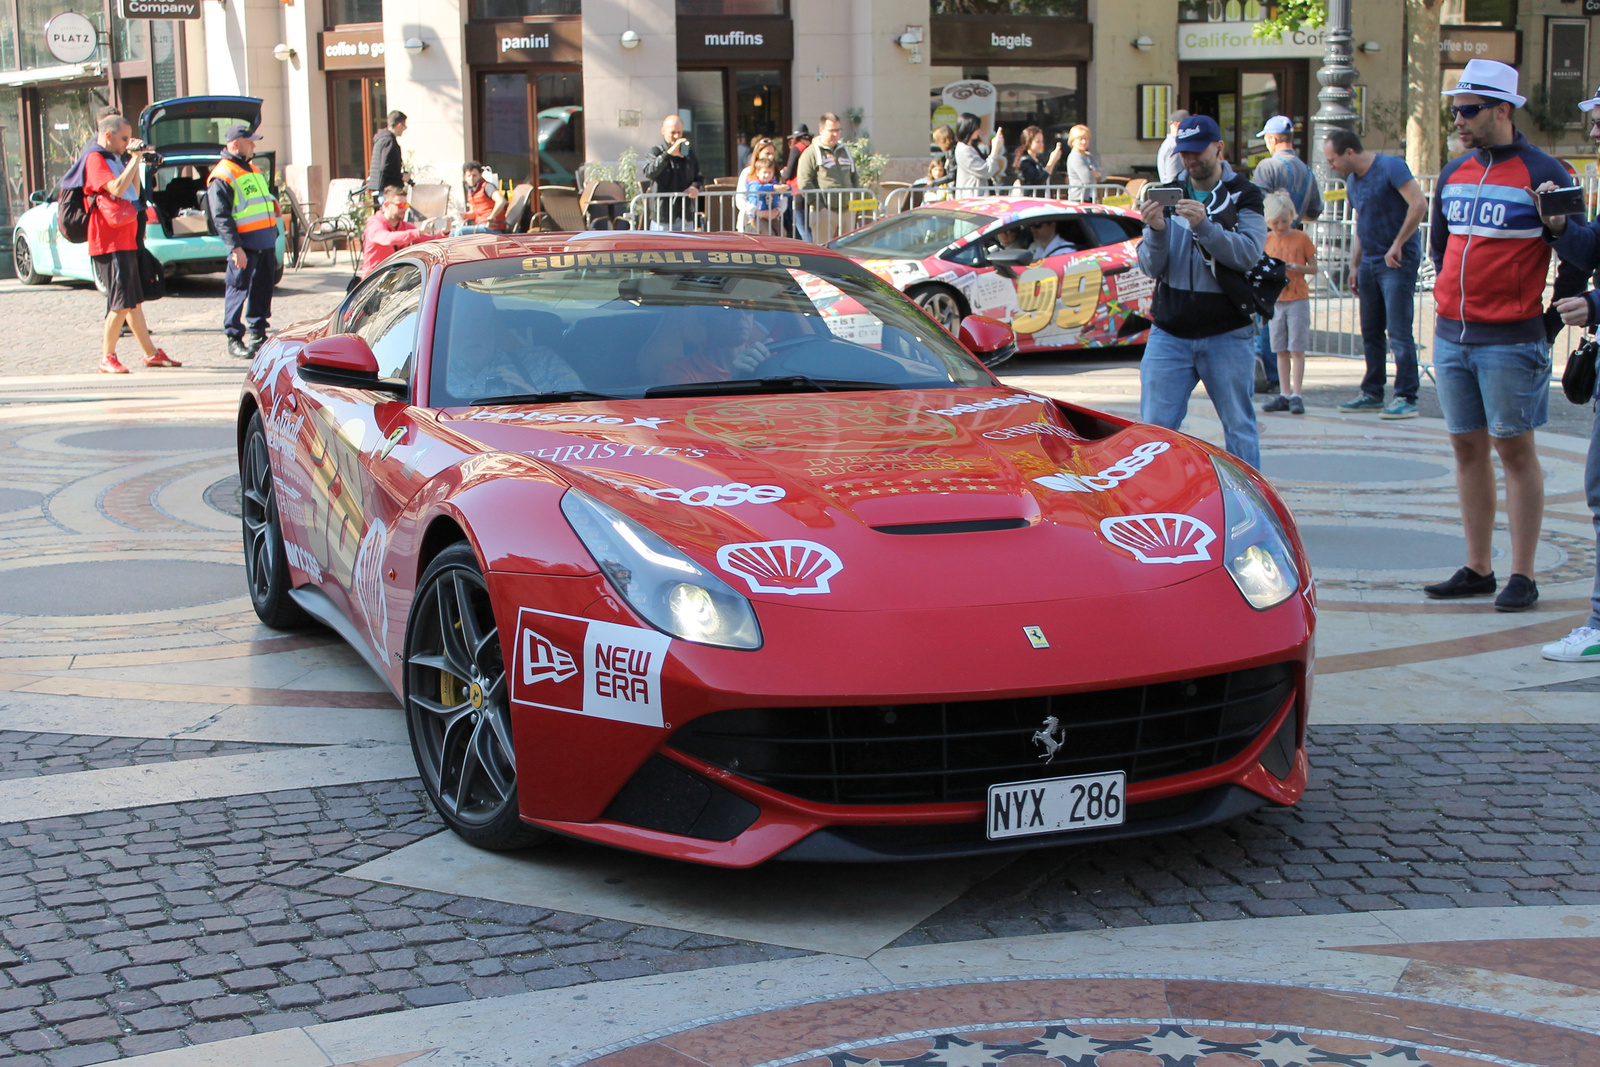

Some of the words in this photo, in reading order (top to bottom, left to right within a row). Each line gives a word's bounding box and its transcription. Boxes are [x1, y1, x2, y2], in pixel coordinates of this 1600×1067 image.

[129, 1, 195, 15] Company
[53, 34, 90, 43] PLATZ
[501, 34, 549, 52] panini
[704, 31, 764, 46] muffins
[991, 32, 1033, 49] bagels
[1184, 32, 1284, 49] California
[326, 41, 357, 57] coffee
[358, 42, 370, 55] to
[371, 42, 385, 57] go
[1439, 40, 1461, 51] offee
[1463, 41, 1474, 51] to
[1475, 42, 1488, 54] go
[521, 251, 701, 271] GUMBALL
[708, 252, 801, 267] 3000
[1011, 263, 1102, 334] 99
[468, 410, 624, 425] betsafe
[804, 454, 911, 467] DUBLIN
[915, 452, 955, 461] TO
[804, 461, 975, 477] BUCHAREST
[595, 643, 652, 677] NEW
[595, 671, 649, 705] ERA
[993, 786, 1046, 832] NYX
[1069, 779, 1121, 823] 286
